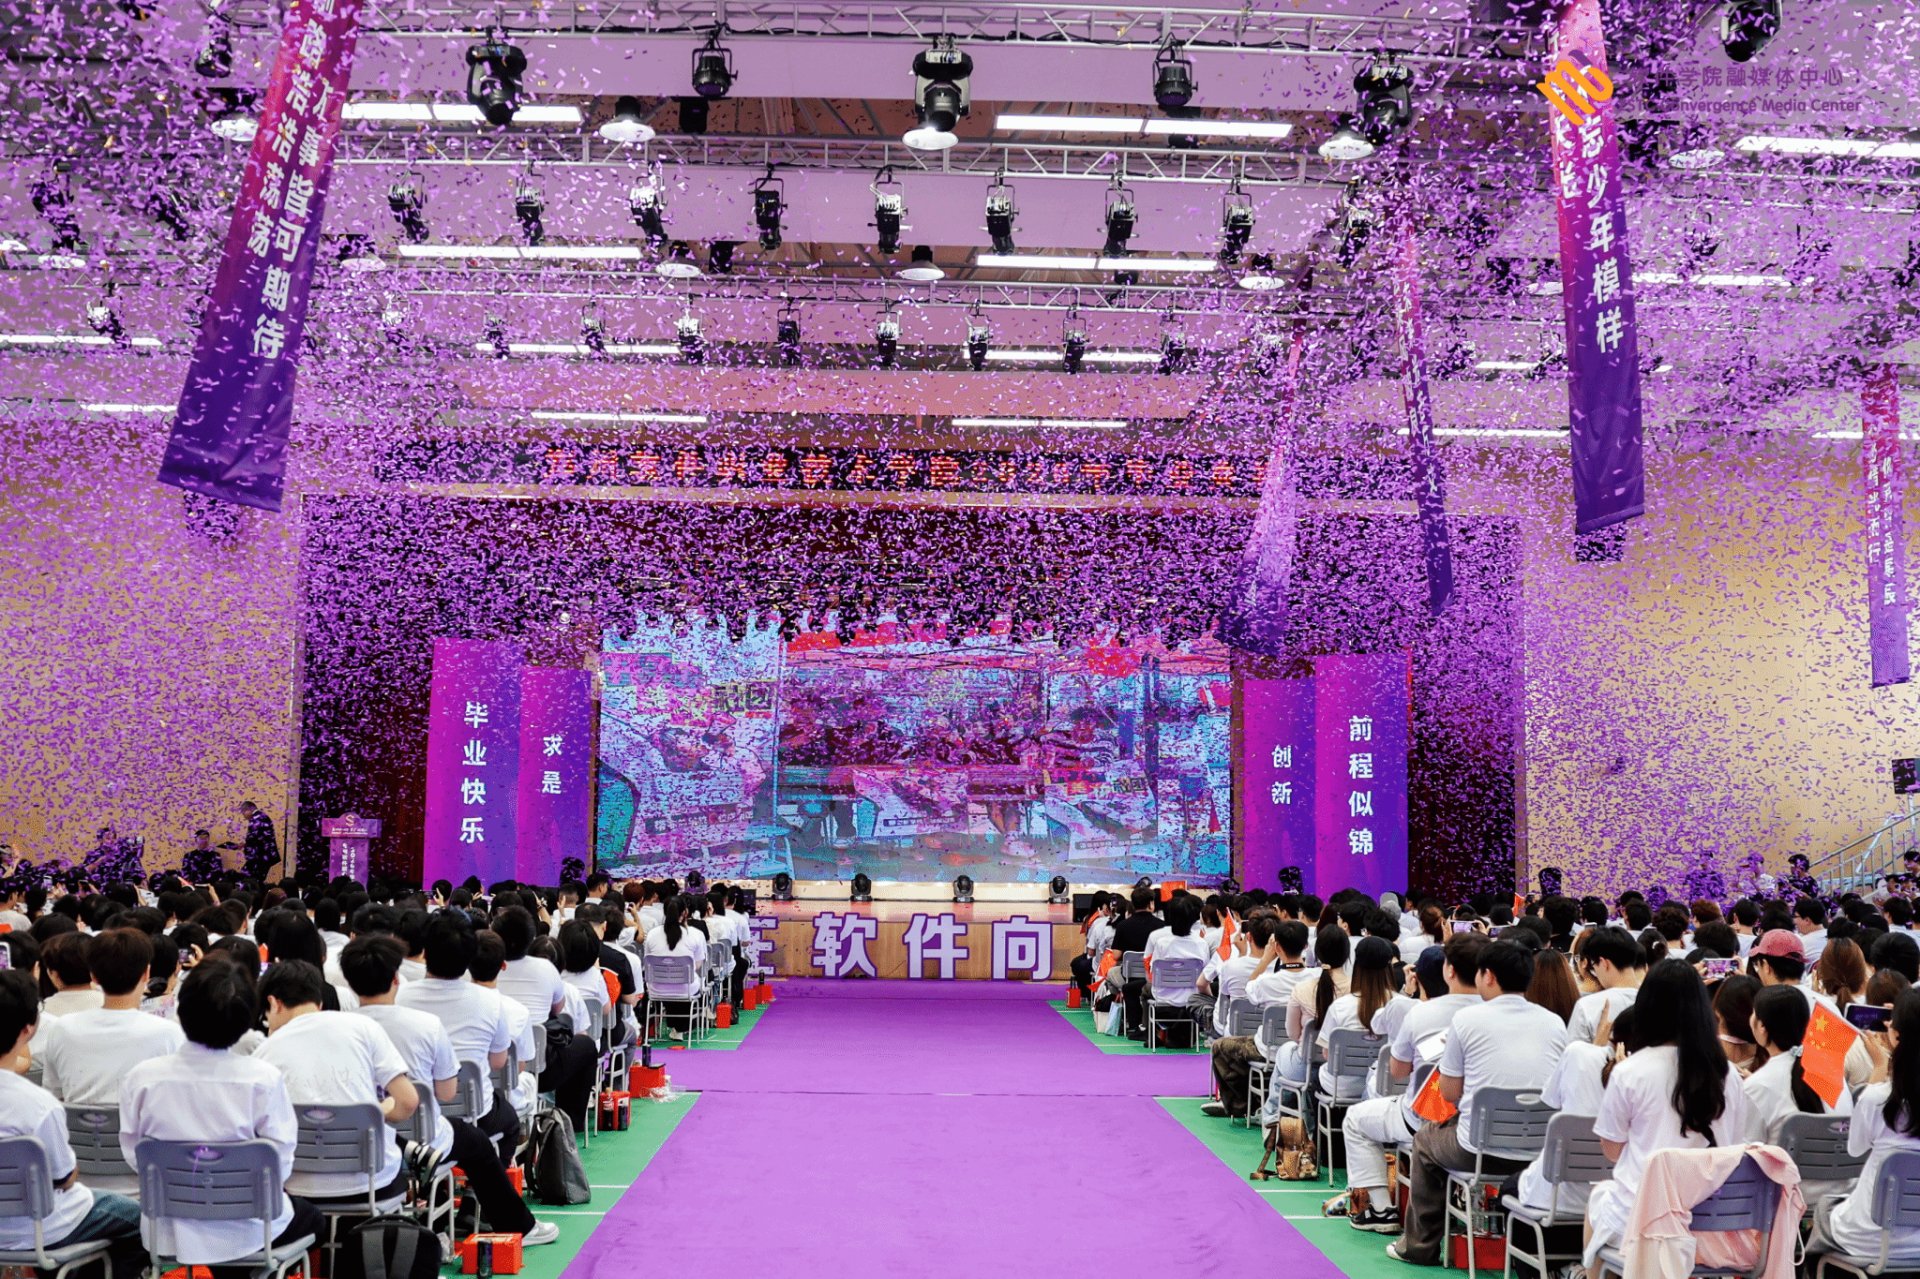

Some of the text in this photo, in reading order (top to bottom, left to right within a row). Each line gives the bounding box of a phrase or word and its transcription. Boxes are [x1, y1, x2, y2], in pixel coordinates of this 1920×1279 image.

[252, 77, 335, 360] 万事皆可期待
[459, 701, 489, 844] 毕业快乐
[541, 734, 563, 795] 求是
[1271, 744, 1293, 805] 创新
[1348, 714, 1374, 855] 前程似锦
